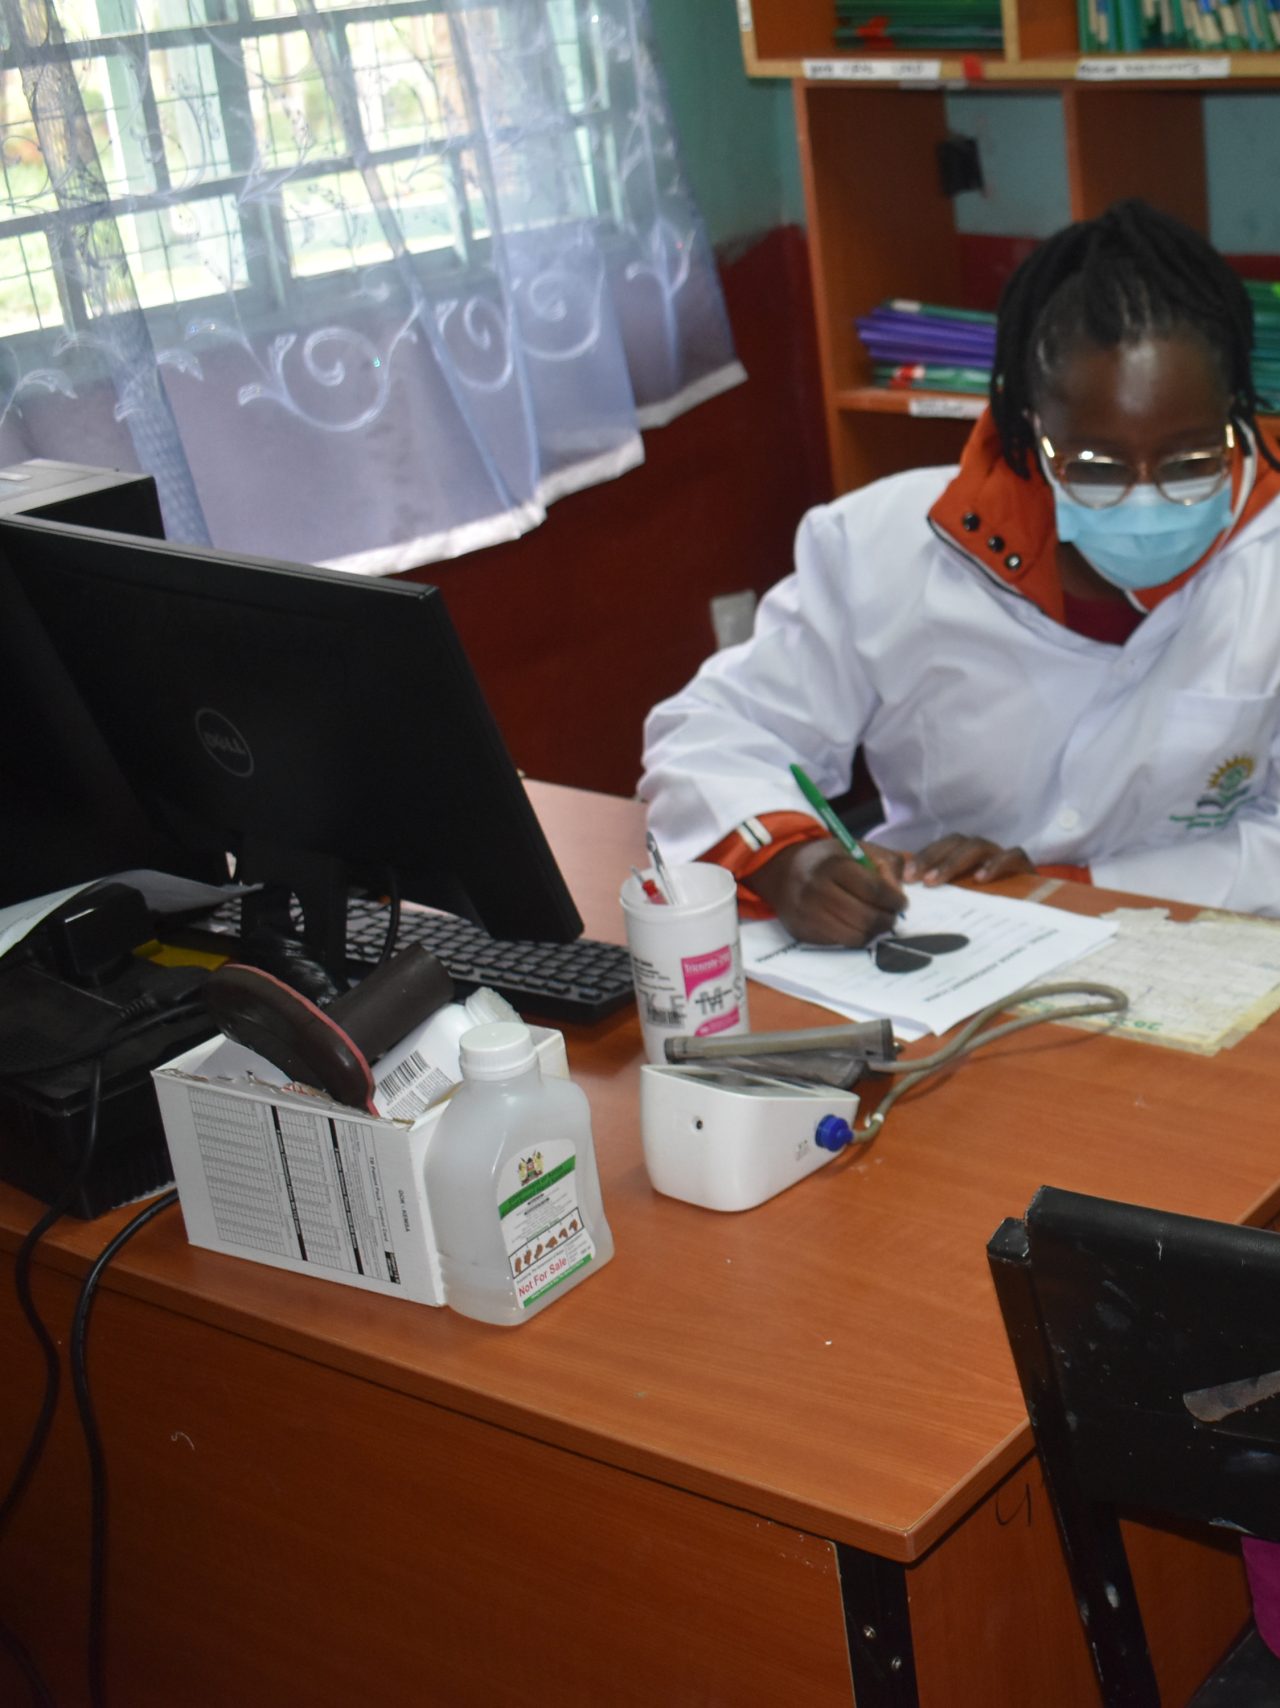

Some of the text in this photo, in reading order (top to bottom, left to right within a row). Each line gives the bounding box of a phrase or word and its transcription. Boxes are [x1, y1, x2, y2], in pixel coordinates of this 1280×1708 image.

[518, 1281, 533, 1297] Not
[533, 1270, 549, 1287] For
[550, 1257, 567, 1275] Sale
